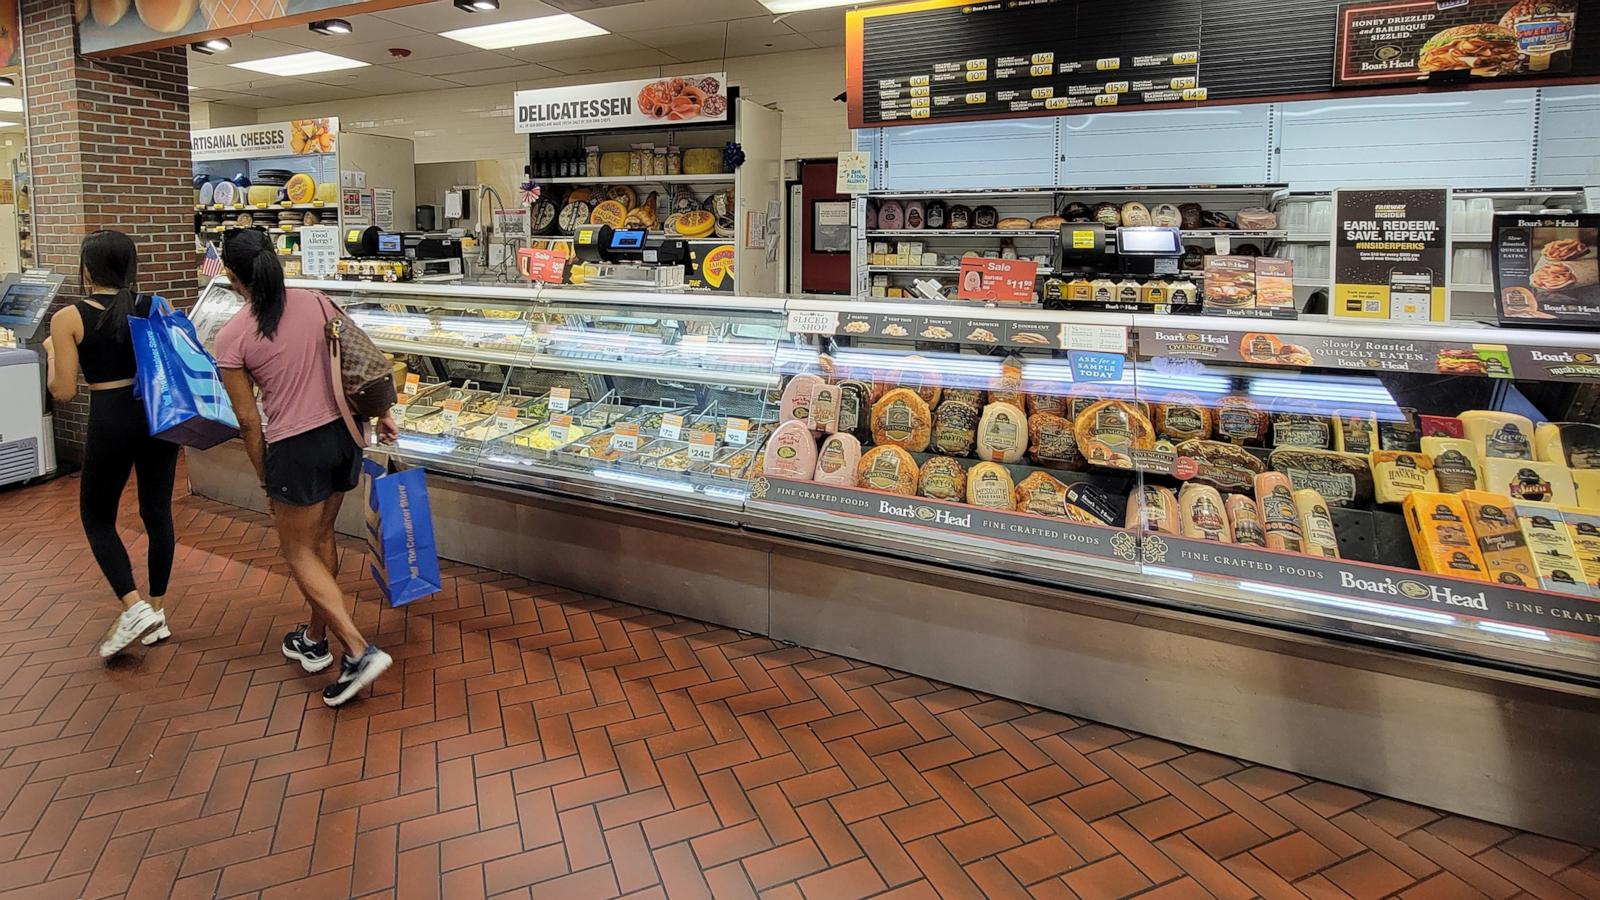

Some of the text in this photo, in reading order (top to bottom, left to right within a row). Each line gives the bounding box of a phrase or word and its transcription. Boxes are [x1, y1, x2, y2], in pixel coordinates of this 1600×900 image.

[1352, 13, 1436, 28] HONEY DRIZZLED
[1359, 23, 1426, 35] and BARBEQUE
[1371, 31, 1412, 41] SIZZLED.
[1361, 58, 1414, 71] Boar's Head
[519, 97, 631, 123] DELICATESSEN
[241, 130, 284, 147] CHEESES
[1343, 220, 1440, 231] EARN. REDEEM.
[1518, 219, 1579, 227] Boar's Head
[1346, 231, 1436, 241] SAVE. REPEAT.
[1356, 242, 1425, 250] #INSIDERPERKS
[535, 252, 550, 260] Sale
[987, 262, 1011, 271] Sale
[801, 323, 827, 331] SHOP
[1156, 332, 1229, 344] Boar's Head
[1169, 344, 1217, 353] OVENGOLD
[1322, 340, 1418, 352] Slowly Roasted.
[1099, 357, 1110, 365] for
[1316, 349, 1429, 361] QUICKLY EATEN.
[1531, 351, 1573, 363] Boar's
[1078, 363, 1116, 372] SAMPLE
[1338, 358, 1409, 370] Boar's Head
[1491, 429, 1527, 442] Lacey
[1133, 452, 1174, 461] OVENGOLD
[1388, 470, 1425, 485] HAVARTI
[1518, 484, 1547, 494] Swiss
[777, 488, 869, 507] FINE CRAFTED FOODS
[878, 500, 971, 528] Boar's Head
[983, 519, 1100, 545] FINE CRAFTED FOODS
[1528, 532, 1567, 543] AMERICAN
[1484, 535, 1505, 545] Vermont
[1497, 540, 1516, 551] Cheddar
[1181, 550, 1324, 579] FINE CRAFTED FOODS
[1339, 571, 1489, 611] Boar's Head
[1506, 601, 1544, 615] FINE
